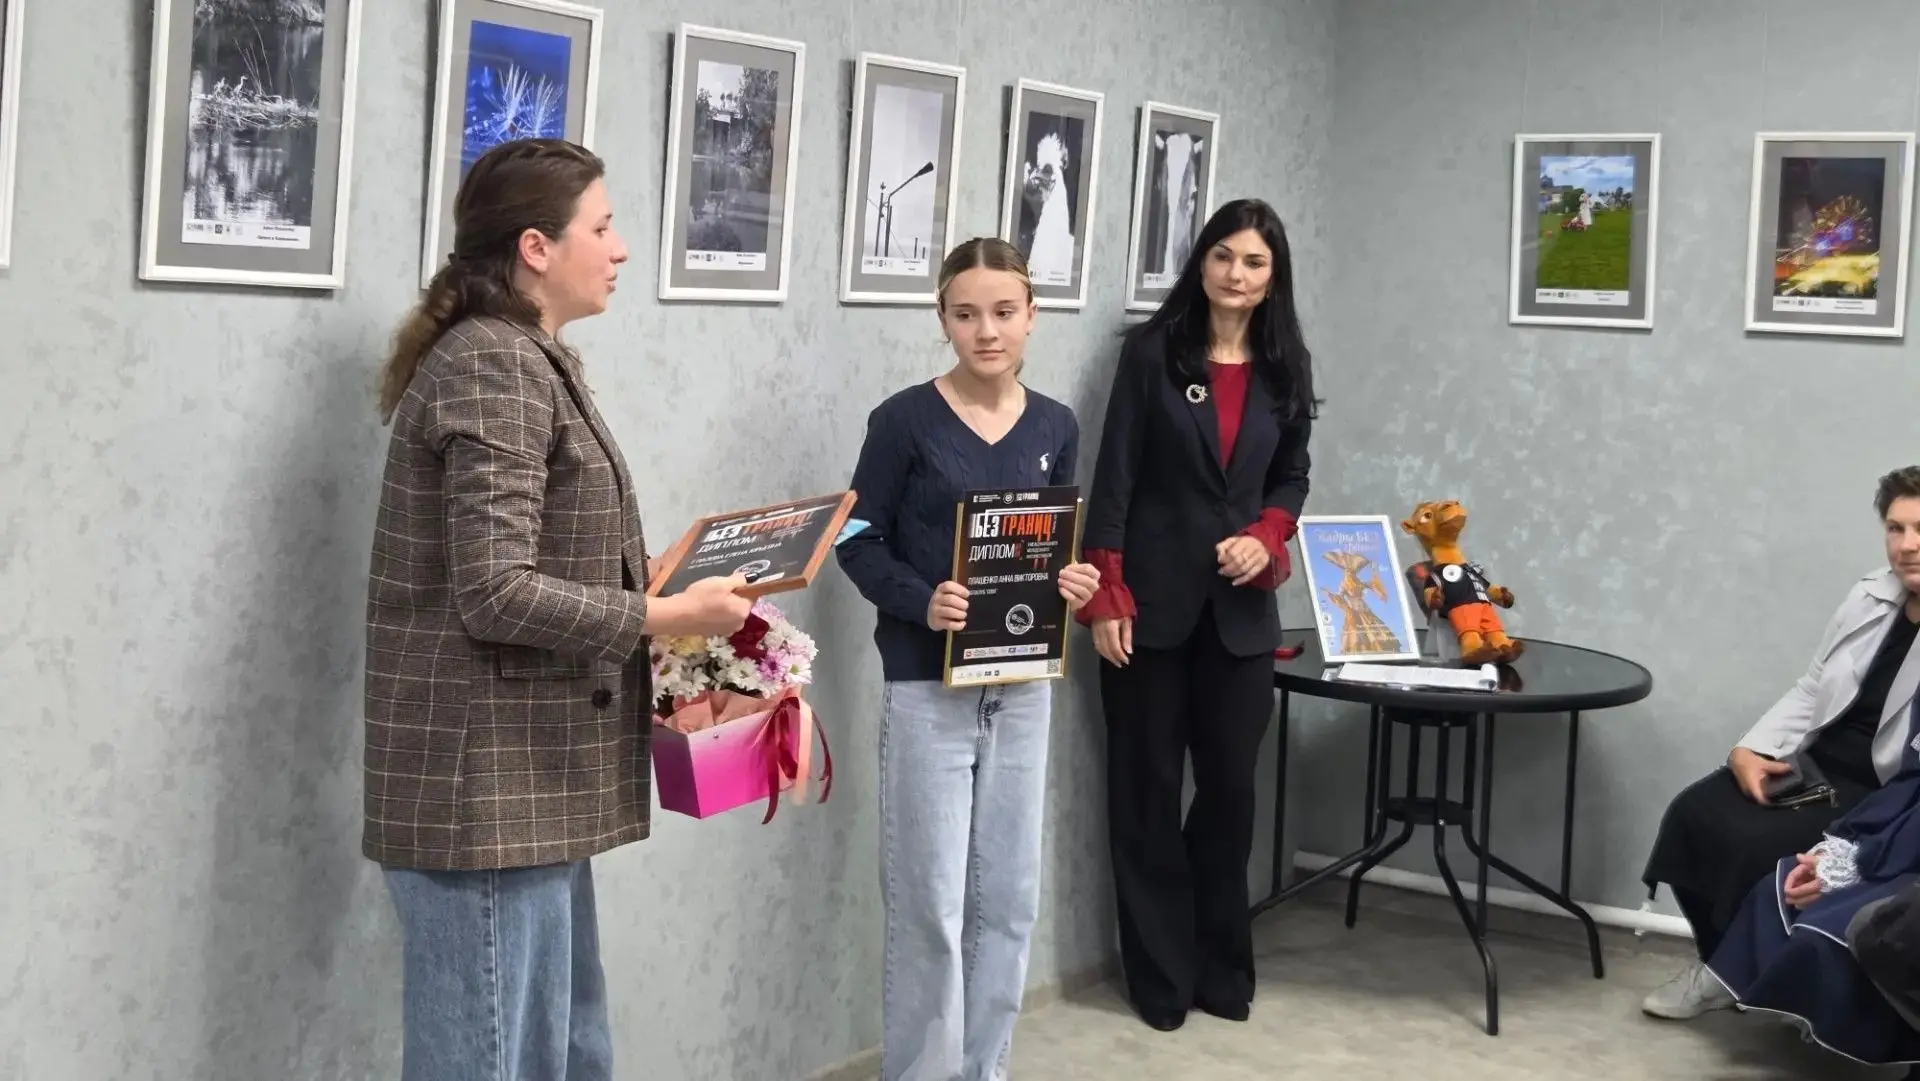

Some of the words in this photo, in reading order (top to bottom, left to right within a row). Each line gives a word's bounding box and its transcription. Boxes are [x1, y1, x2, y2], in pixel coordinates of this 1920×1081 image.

[971, 513, 1000, 538] БЕЗ
[1002, 513, 1052, 542] ГРАНИЦ
[696, 535, 757, 554] ДИПЛОМ
[968, 543, 1015, 563] ДИПЛОМ
